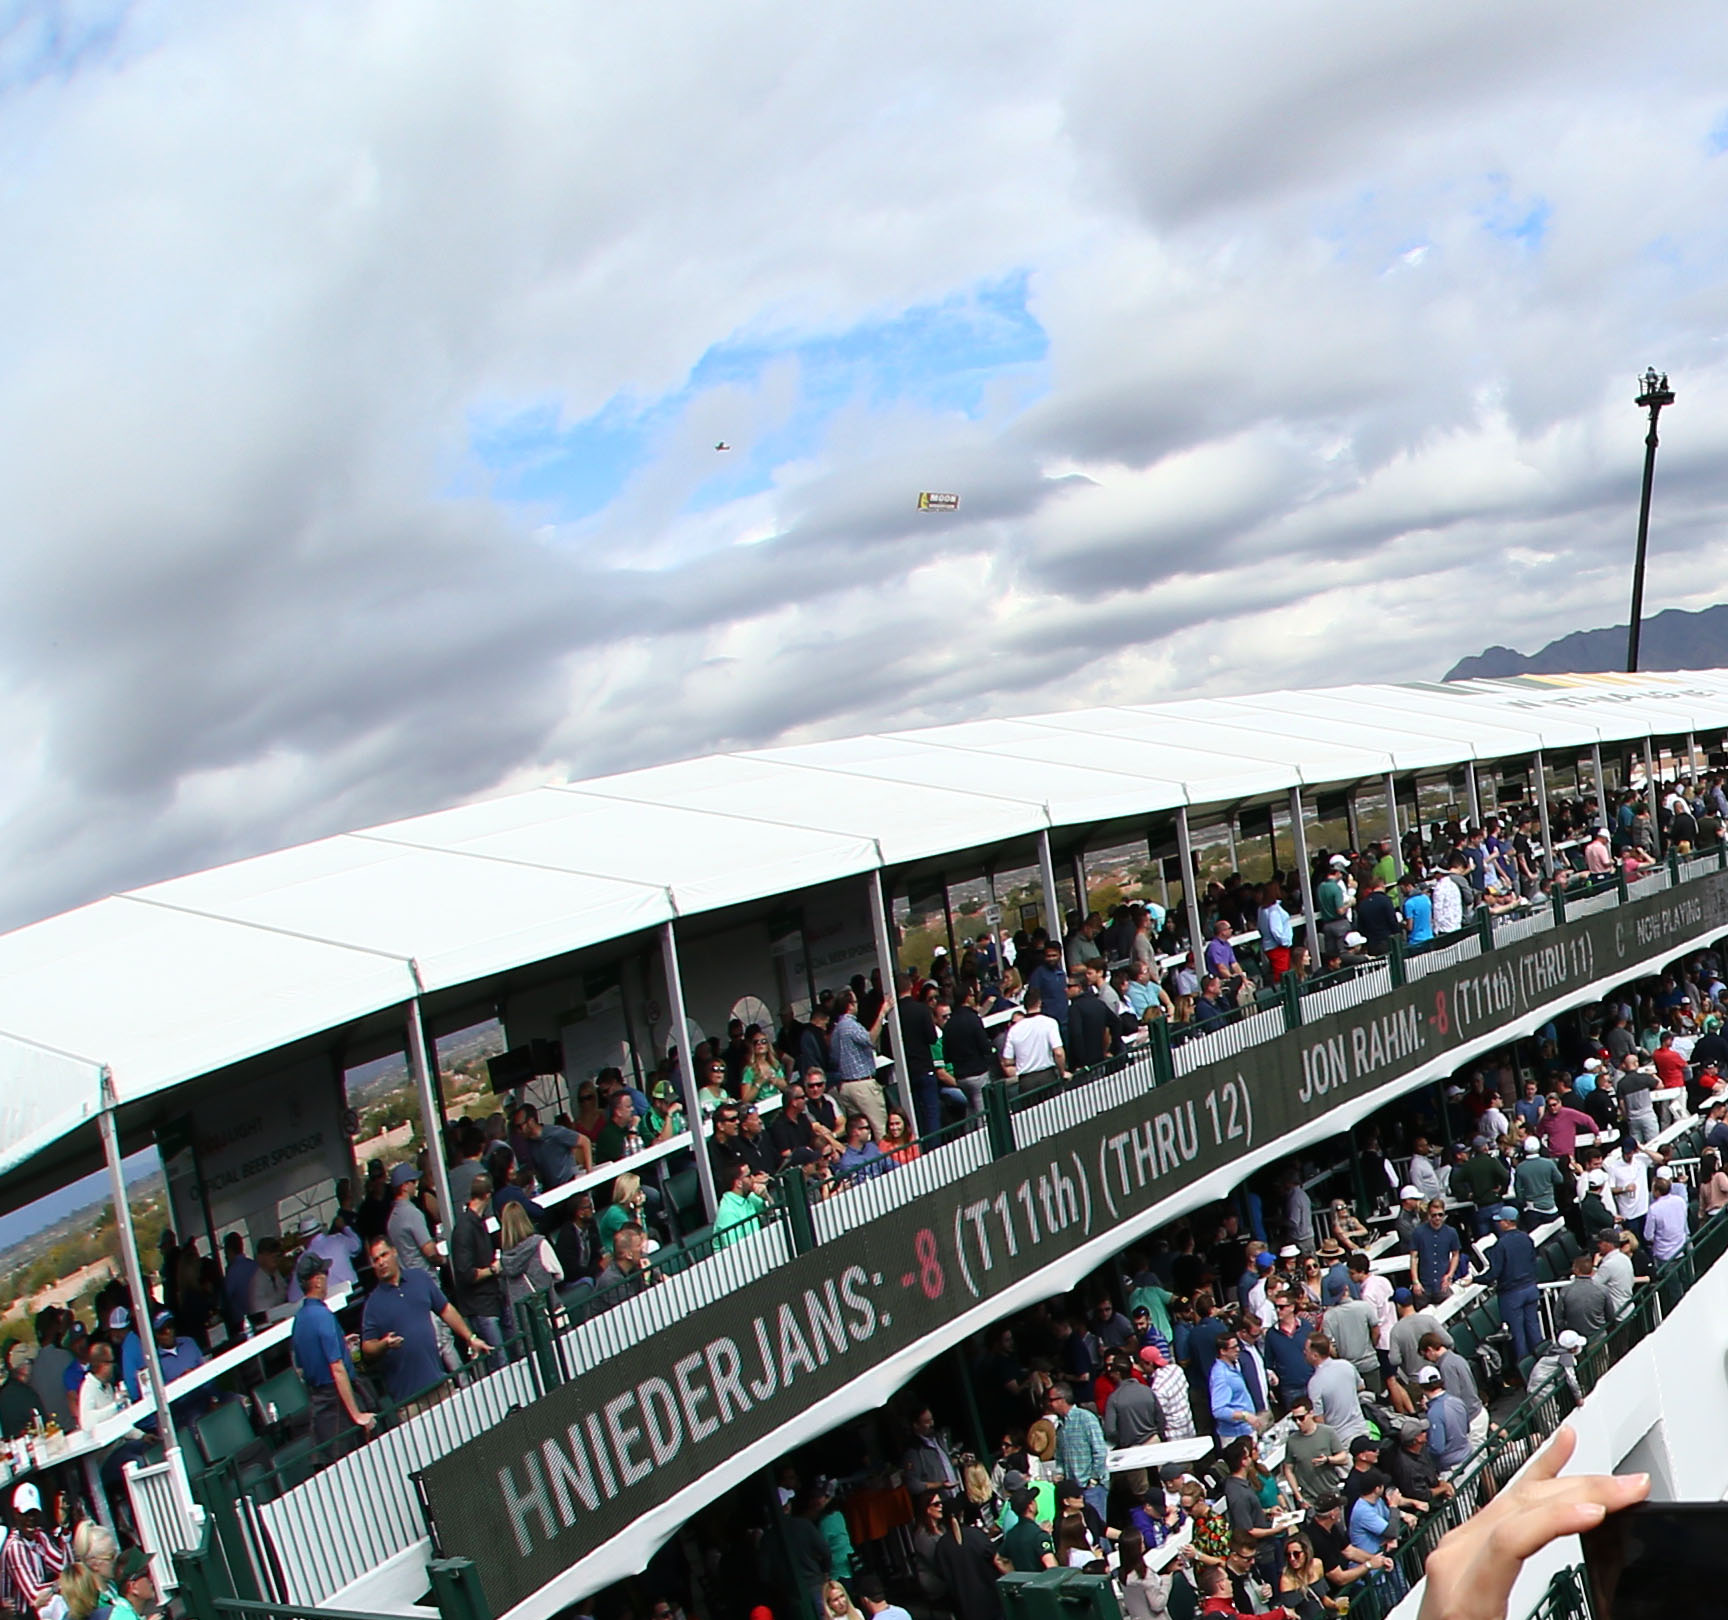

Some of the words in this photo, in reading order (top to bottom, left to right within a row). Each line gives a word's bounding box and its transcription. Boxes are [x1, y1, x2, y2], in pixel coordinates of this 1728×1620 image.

[1299, 1032, 1348, 1104] JON
[1352, 1003, 1426, 1079] RAHM:
[1429, 990, 1449, 1036] -8
[1453, 960, 1517, 1040] (T11th)
[1519, 941, 1568, 1010] (THRU
[1569, 930, 1593, 979] 11)
[498, 1263, 893, 1558] HNIEDERJANS:
[901, 1227, 944, 1300] -8
[953, 1150, 1092, 1298] (T11th)
[1099, 1100, 1200, 1221] (THRU
[1204, 1071, 1254, 1148] 12)
